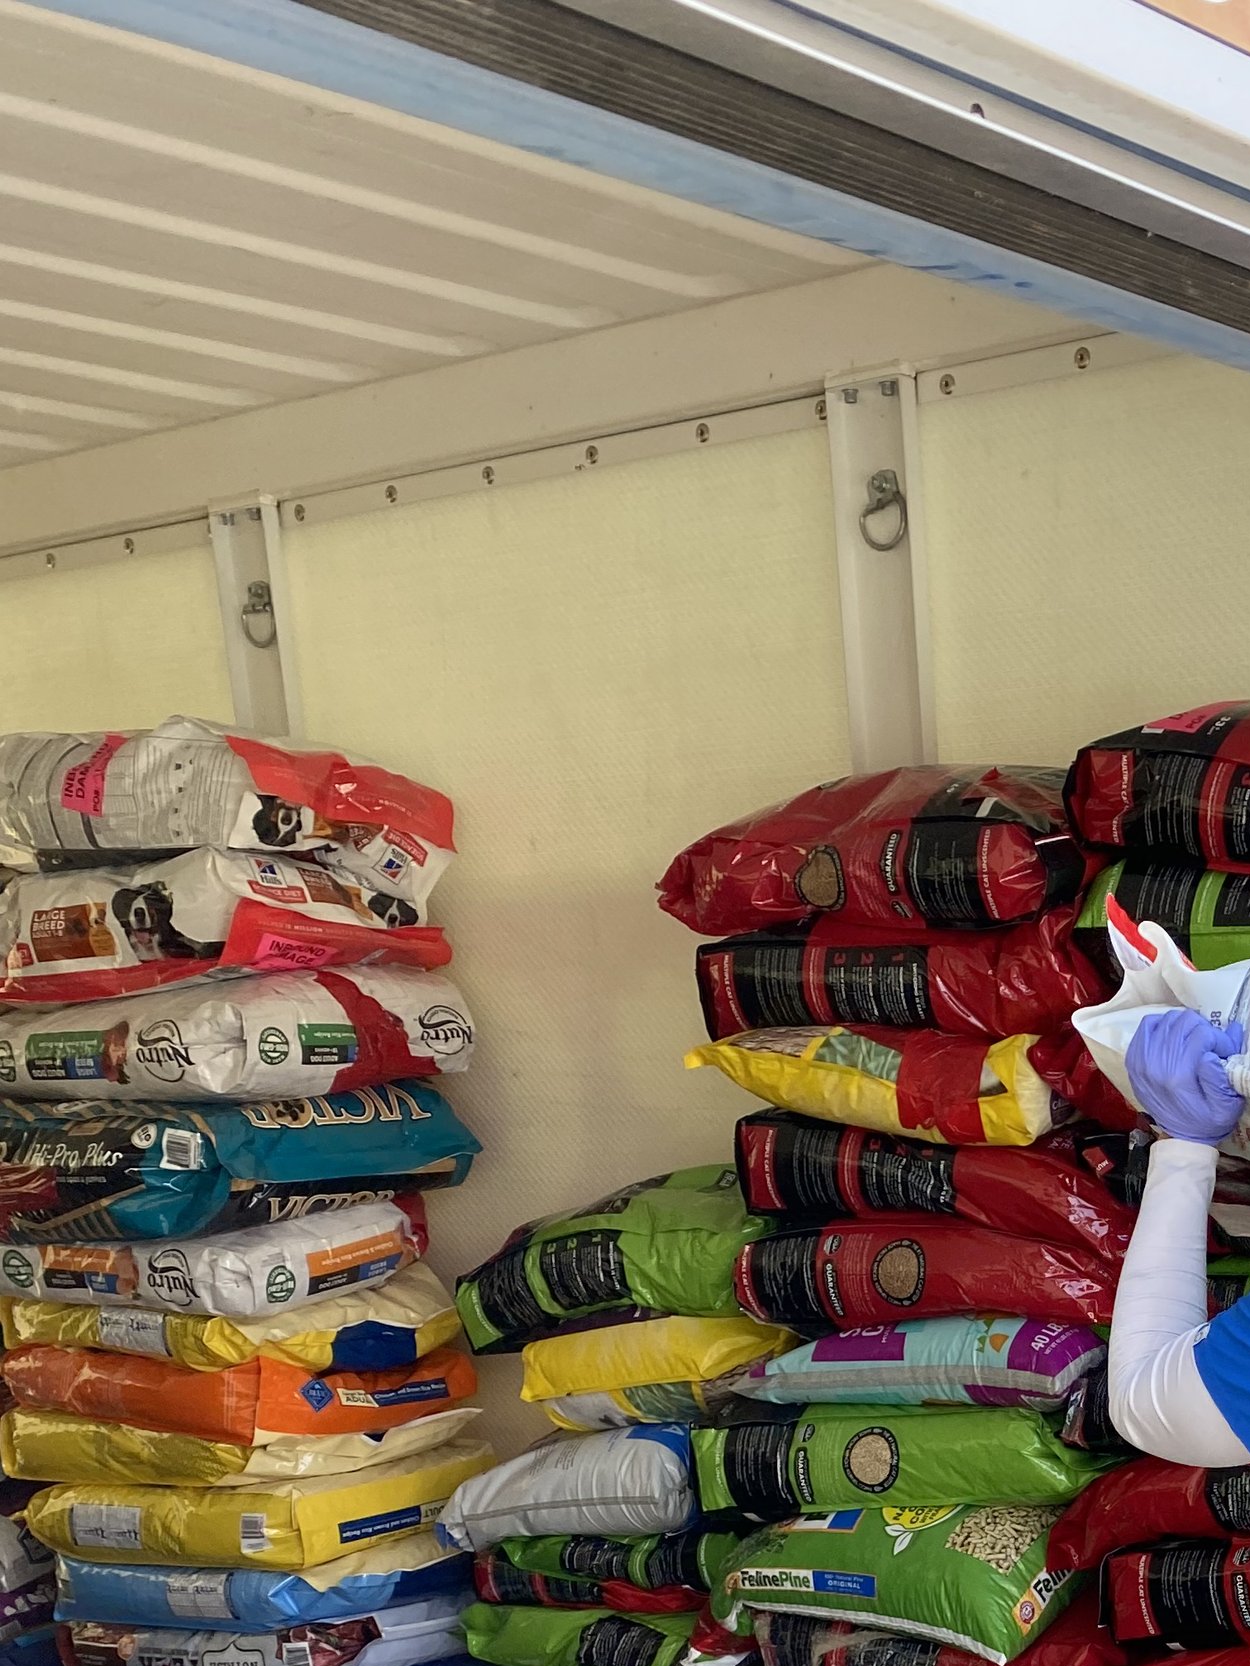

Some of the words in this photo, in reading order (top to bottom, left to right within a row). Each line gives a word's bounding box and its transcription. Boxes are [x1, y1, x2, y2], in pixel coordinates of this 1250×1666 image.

[886, 832, 899, 892] GUARANTEED
[834, 952, 846, 964] 3
[861, 952, 873, 964] 2
[421, 1026, 473, 1045] Nutro
[136, 1046, 196, 1069] Nutro
[83, 1141, 124, 1167] Plus
[147, 1273, 201, 1299] Nutro
[825, 1263, 843, 1316] GUARANTEED
[1030, 1335, 1046, 1352] 40
[798, 1450, 811, 1502] GUARANTEED
[740, 1570, 810, 1589] FelinePine
[828, 1580, 860, 1590] ORIGINAL
